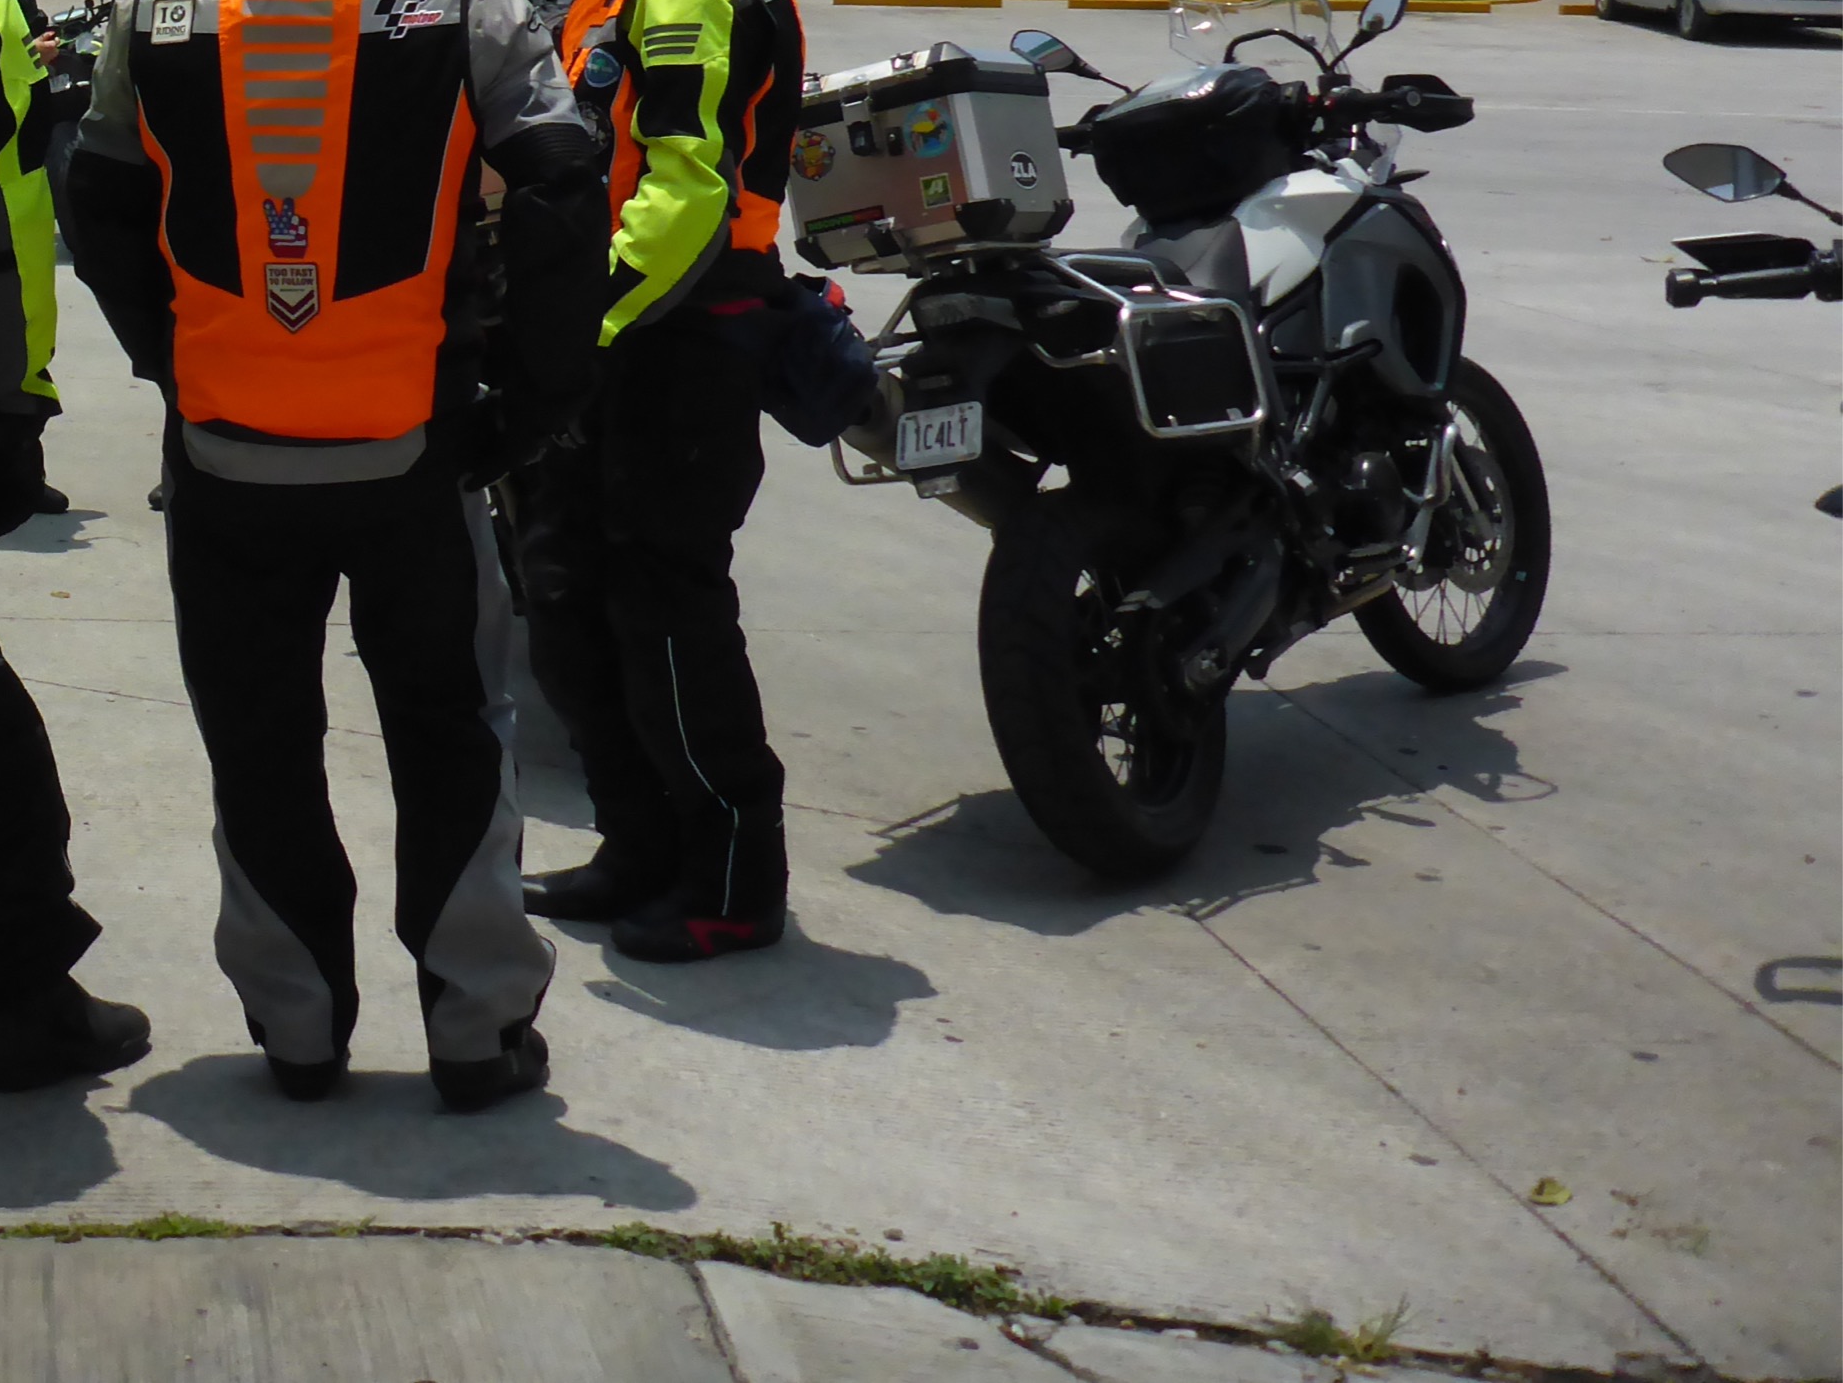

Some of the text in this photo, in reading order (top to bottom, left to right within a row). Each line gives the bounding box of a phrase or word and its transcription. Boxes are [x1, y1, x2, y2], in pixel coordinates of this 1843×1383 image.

[156, 25, 186, 36] RIDING
[1011, 161, 1037, 179] ZLA
[268, 268, 287, 277] TOO
